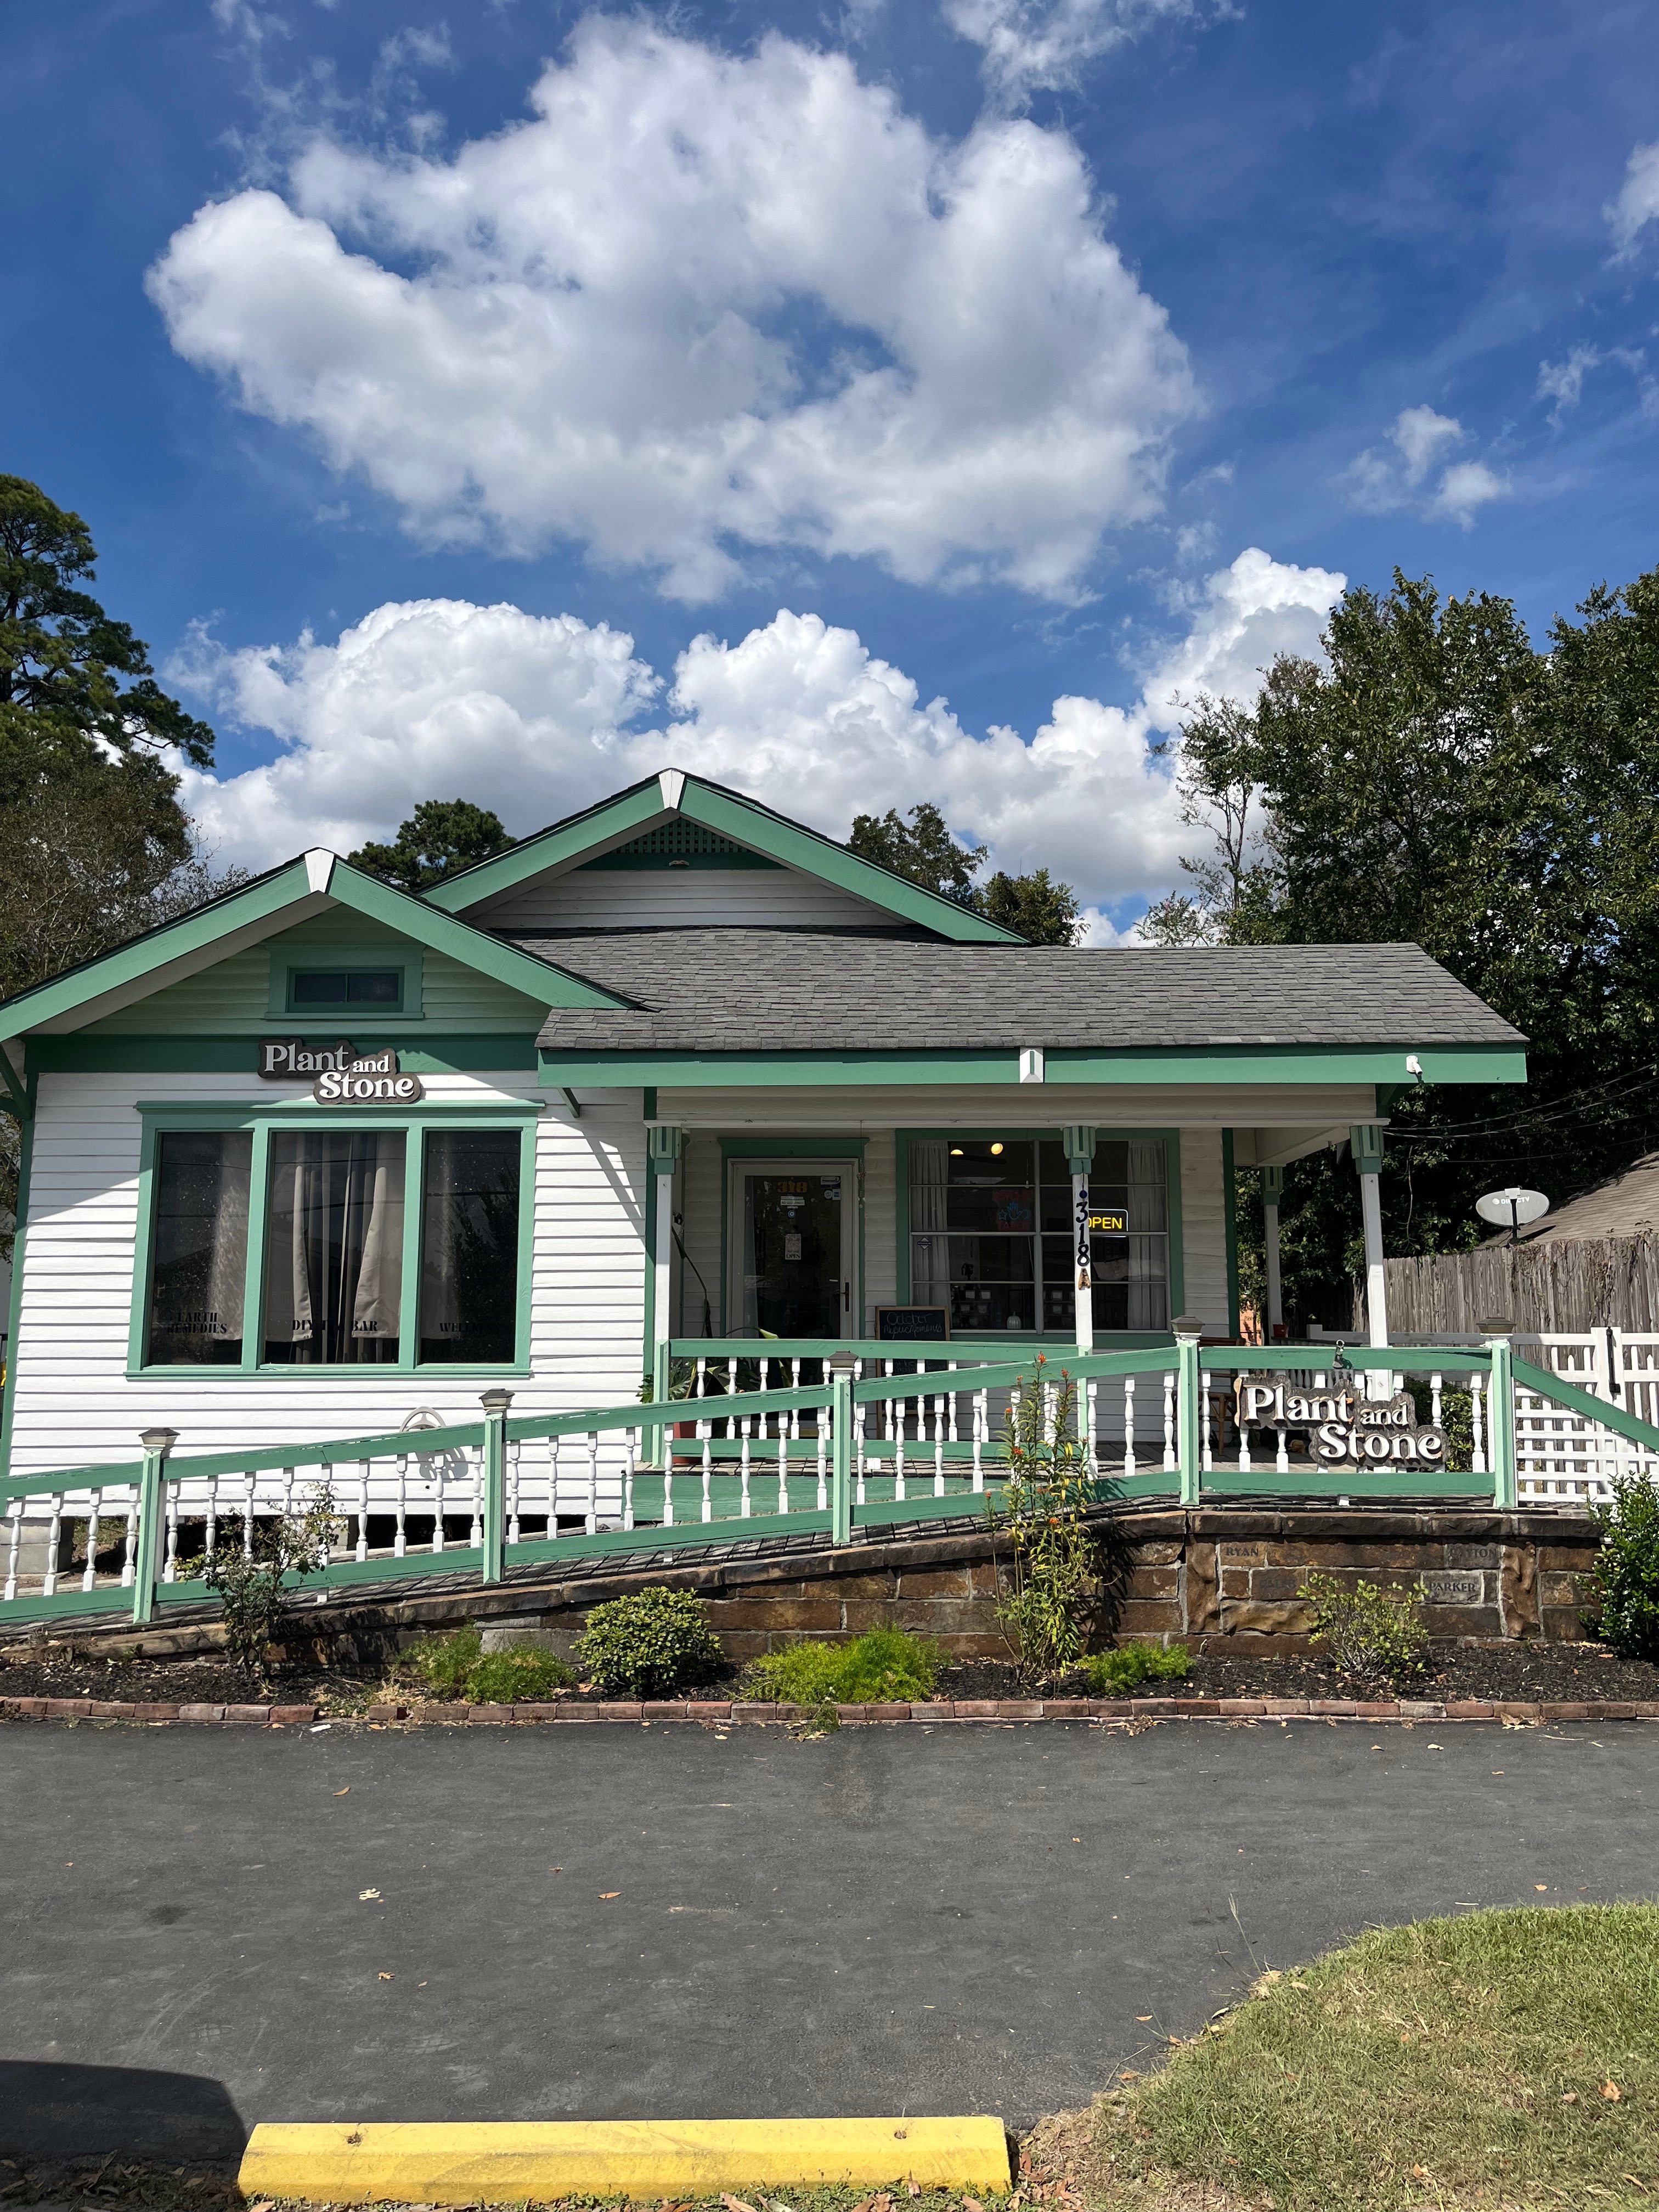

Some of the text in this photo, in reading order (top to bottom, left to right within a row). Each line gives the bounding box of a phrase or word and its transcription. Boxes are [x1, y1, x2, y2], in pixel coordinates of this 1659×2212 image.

[264, 1043, 390, 1073] Plant and
[319, 1071, 414, 1098] Stone
[777, 1181, 808, 1193] 318
[1501, 1196, 1530, 1204] DIRCTV
[1076, 1201, 1090, 1267] 318
[178, 1312, 218, 1322] EARTH
[292, 1319, 314, 1330] DIY
[351, 1321, 378, 1331] BAR
[1243, 1383, 1408, 1426] Plant and
[1318, 1423, 1442, 1460] Stone
[1225, 1547, 1259, 1557] RYAN
[1429, 1582, 1476, 1592] PARKER
